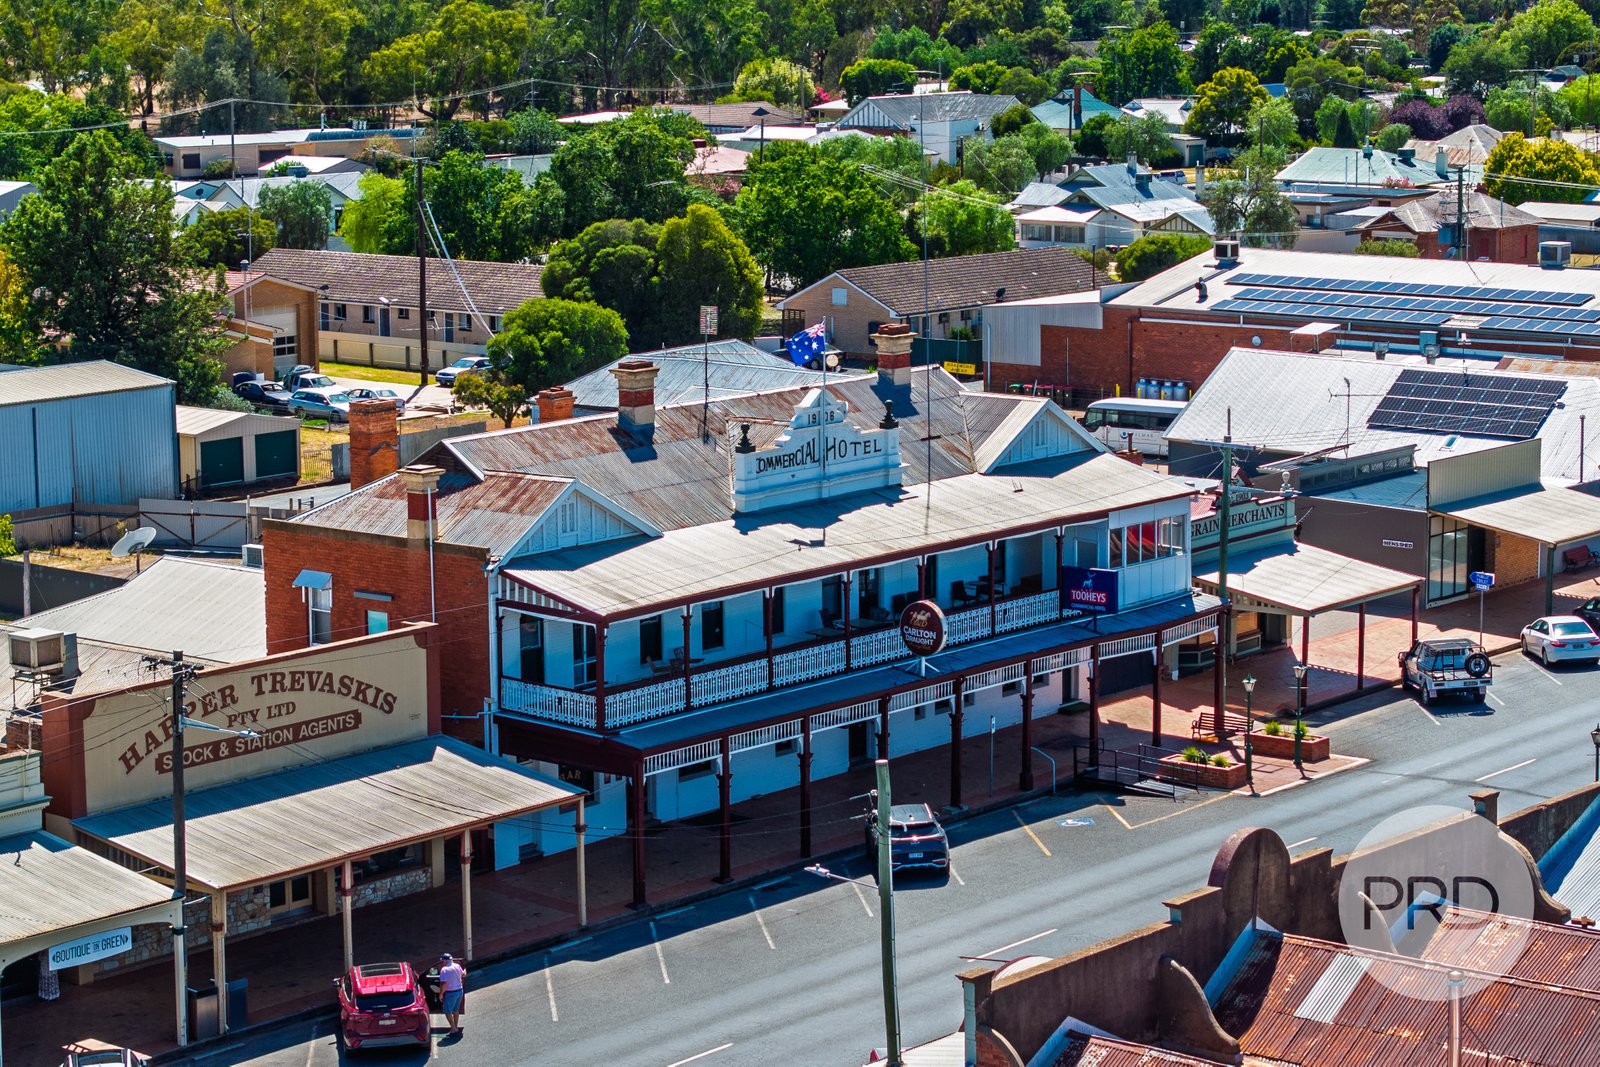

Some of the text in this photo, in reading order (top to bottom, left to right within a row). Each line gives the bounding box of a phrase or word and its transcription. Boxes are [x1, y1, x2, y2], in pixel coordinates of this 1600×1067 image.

[825, 437, 883, 462] HOTEL
[1228, 503, 1286, 528] ERCHANTS
[1071, 590, 1106, 603] TOOHEYS
[903, 625, 937, 640] CARLTON
[905, 634, 934, 646] DRAUGHT
[251, 670, 397, 715] TREVASKIS
[227, 701, 297, 728] PTY LTD
[162, 715, 356, 770] SOCK & STATION AGENTS
[55, 942, 91, 963] BOUTIQUE
[101, 934, 126, 951] GREEN
